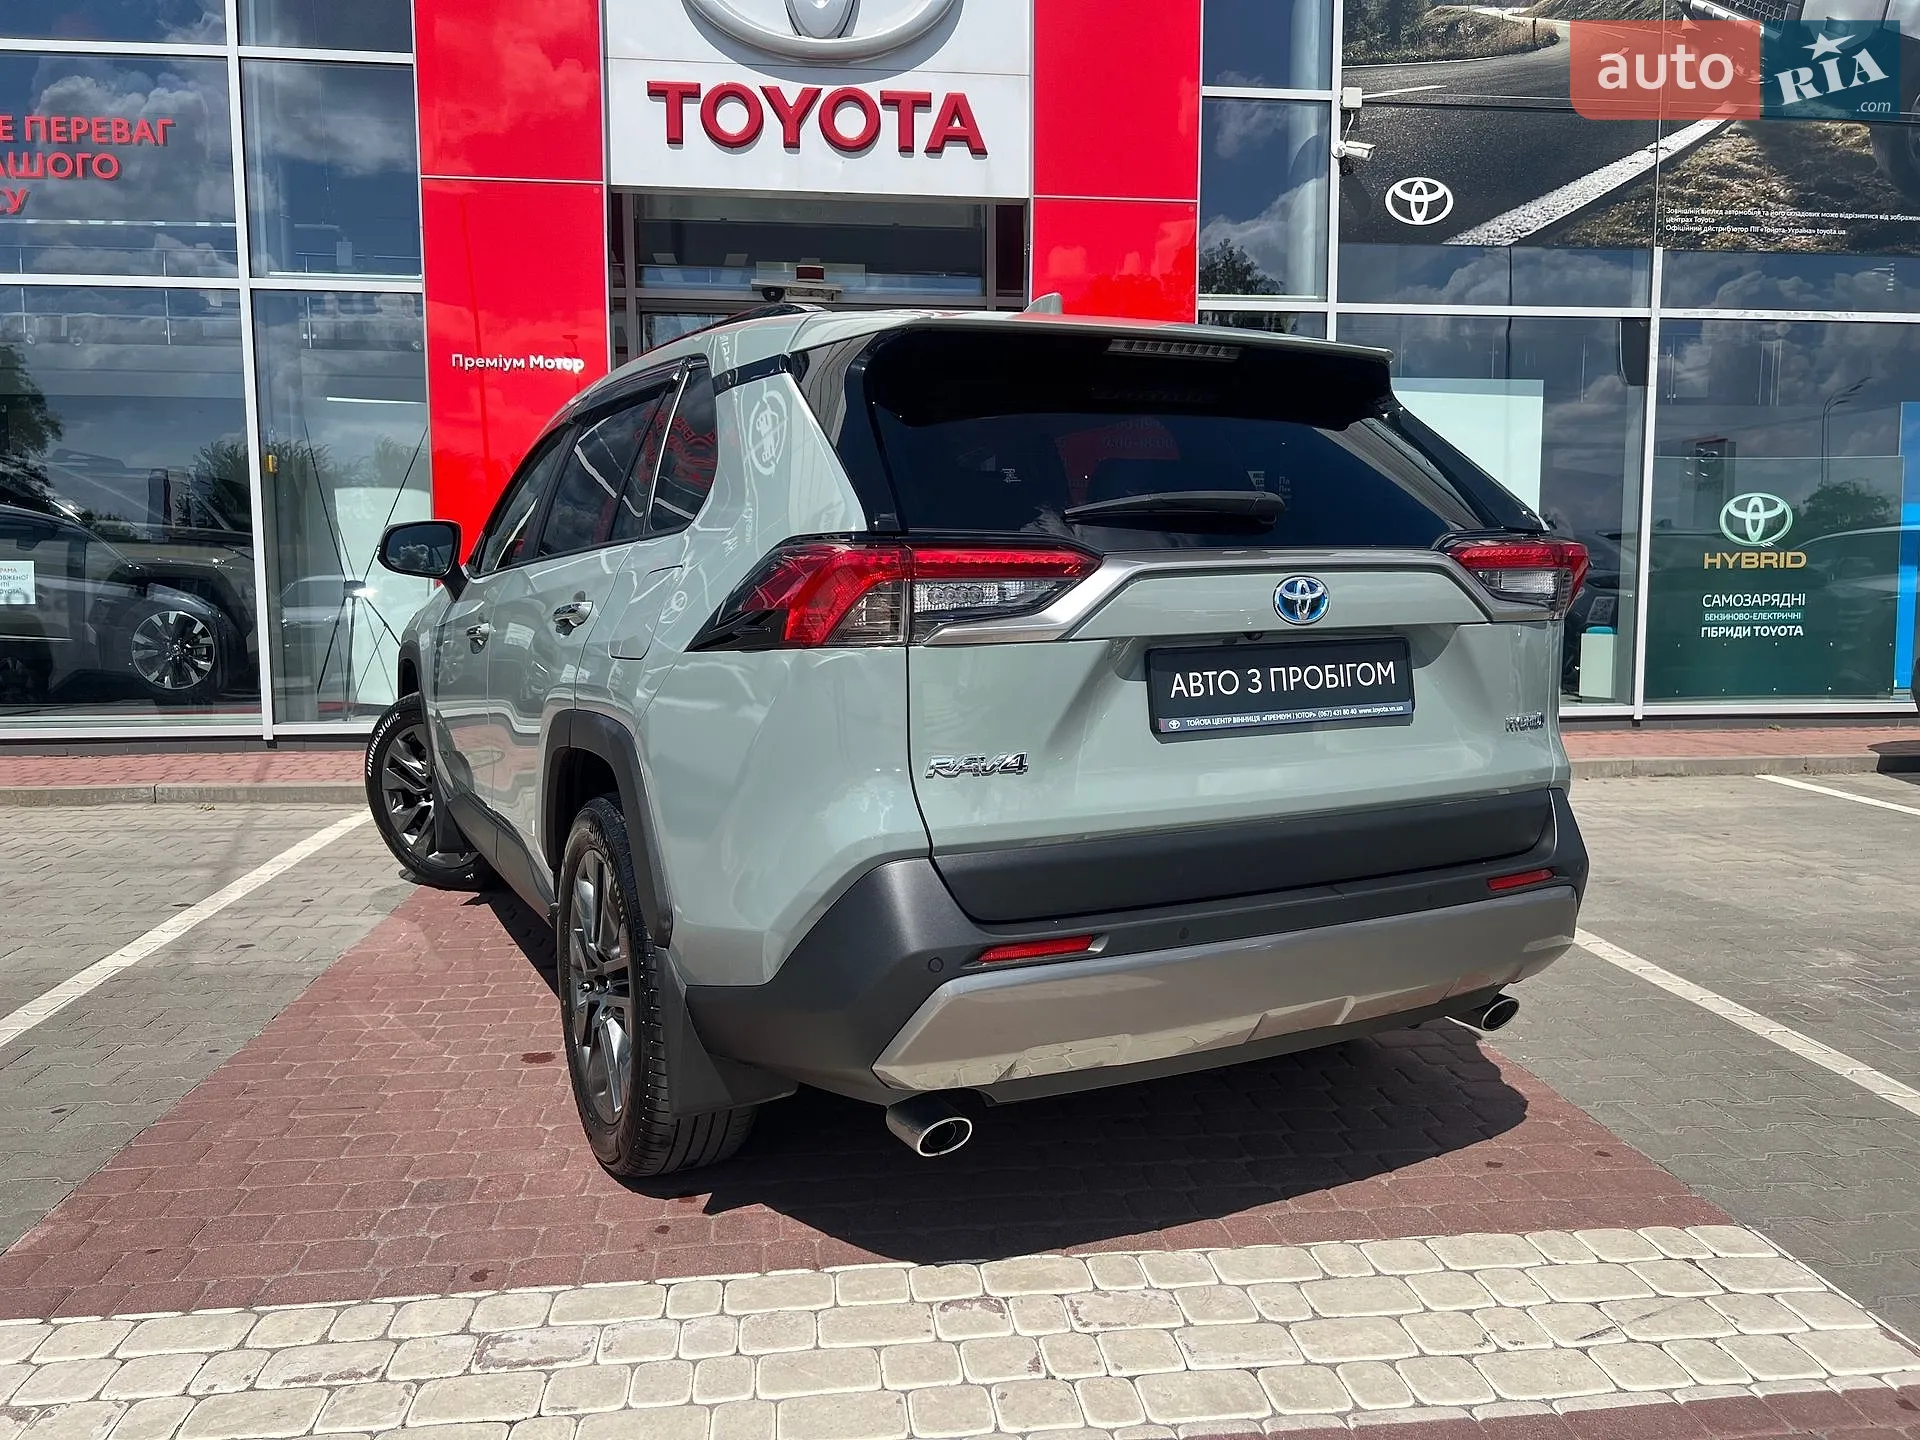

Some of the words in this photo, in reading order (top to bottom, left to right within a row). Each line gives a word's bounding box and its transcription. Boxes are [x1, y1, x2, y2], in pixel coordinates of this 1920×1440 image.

[646, 80, 989, 156] TOYOTA
[25, 115, 175, 145] ПЕРЕВАГ
[0, 151, 120, 180] ШОГО
[1694, 216, 1715, 225] Toyota
[451, 353, 526, 372] Преміум
[529, 354, 585, 375] Мотор
[1703, 551, 1807, 569] HYBRID
[1701, 593, 1806, 608] САМОЗАРЯДНІ
[1704, 612, 1802, 622] БЕНЗИНОВО-ЕЛЕКТРИЧНІ
[1701, 626, 1751, 639] ГІБРИДИ
[1753, 625, 1804, 637] TOYOTA
[1170, 669, 1240, 698] АВТО
[1269, 661, 1396, 692] ПРОБІГОМ
[1186, 719, 1212, 727] ТОЙОТА
[1212, 717, 1232, 726] ЦЕНТР
[1233, 715, 1261, 724] ВІННИЦЯ
[1318, 710, 1333, 718] (067)
[1358, 706, 1404, 714] www.toyota.vn.ua
[925, 752, 1029, 779] RAV4
